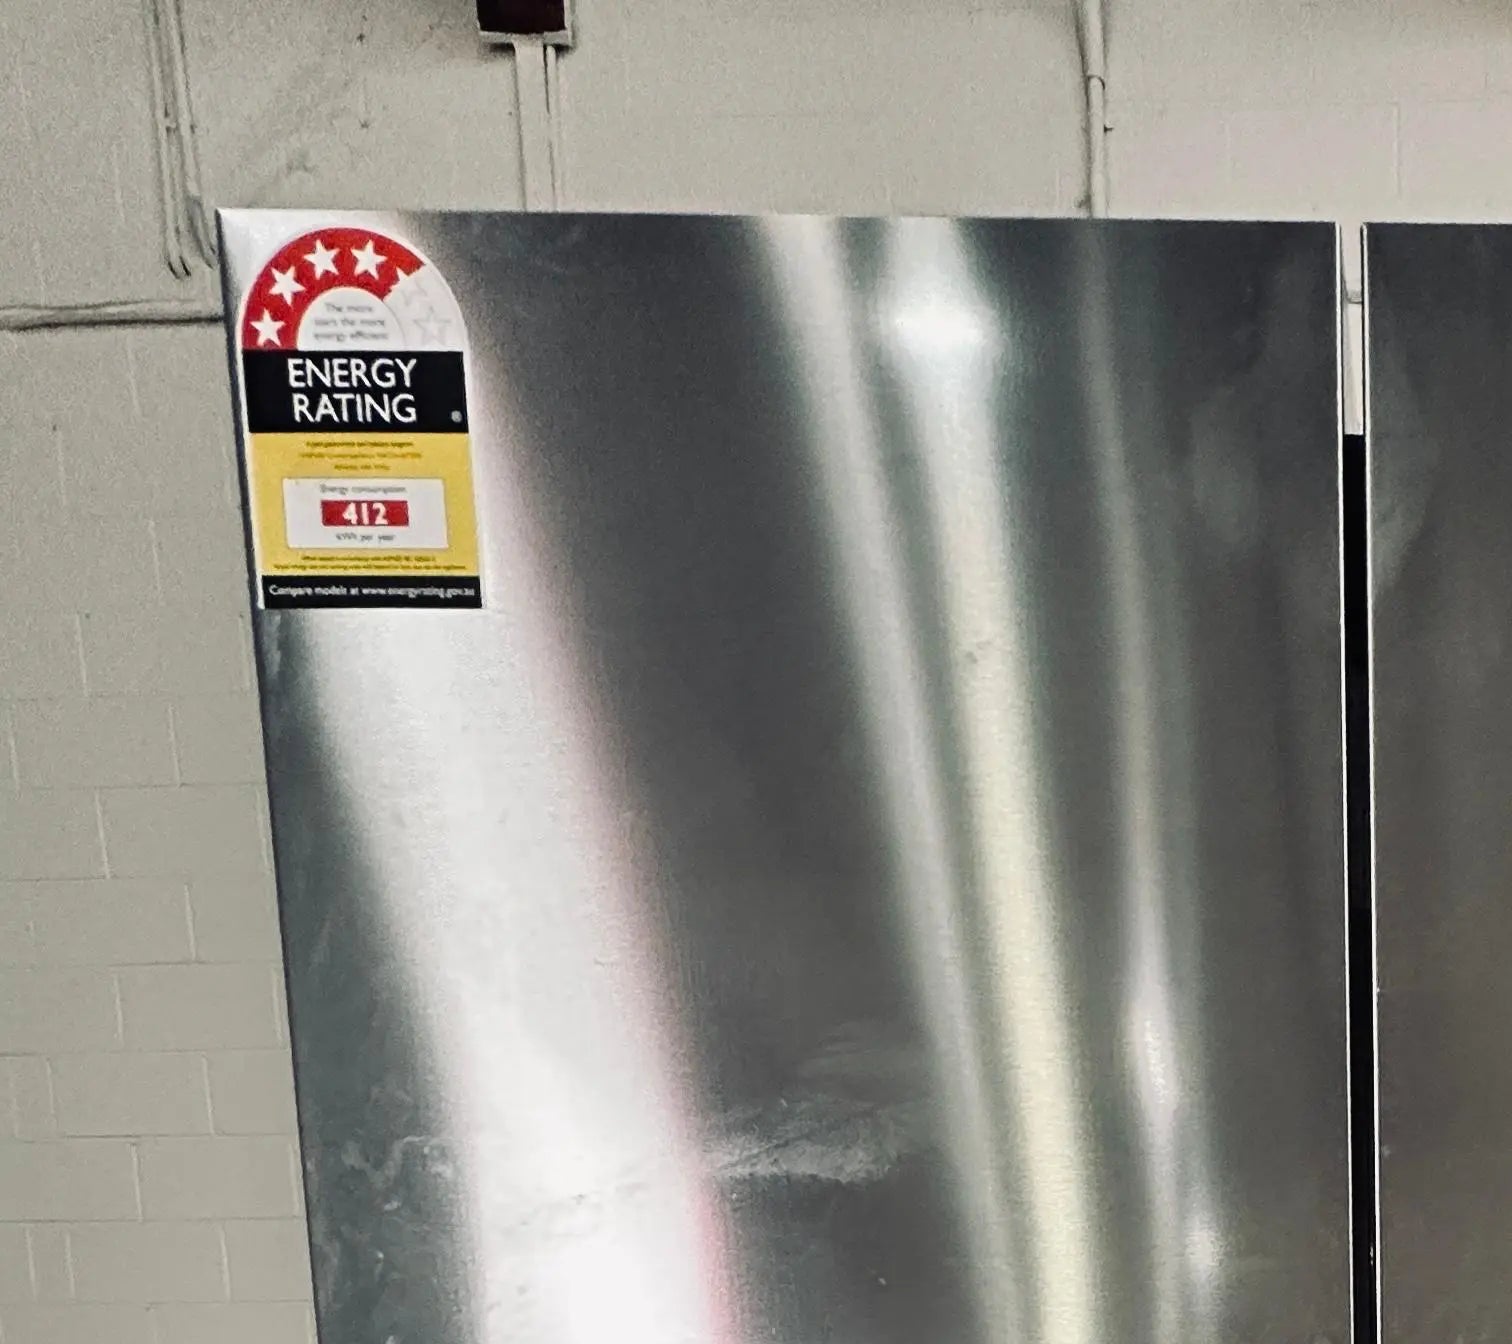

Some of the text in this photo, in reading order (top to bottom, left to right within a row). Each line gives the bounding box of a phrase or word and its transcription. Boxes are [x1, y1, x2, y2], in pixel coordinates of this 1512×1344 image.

[287, 358, 417, 388] ENERGY
[292, 393, 417, 423] RATING
[342, 502, 388, 525] 412
[269, 584, 312, 598] Compare
